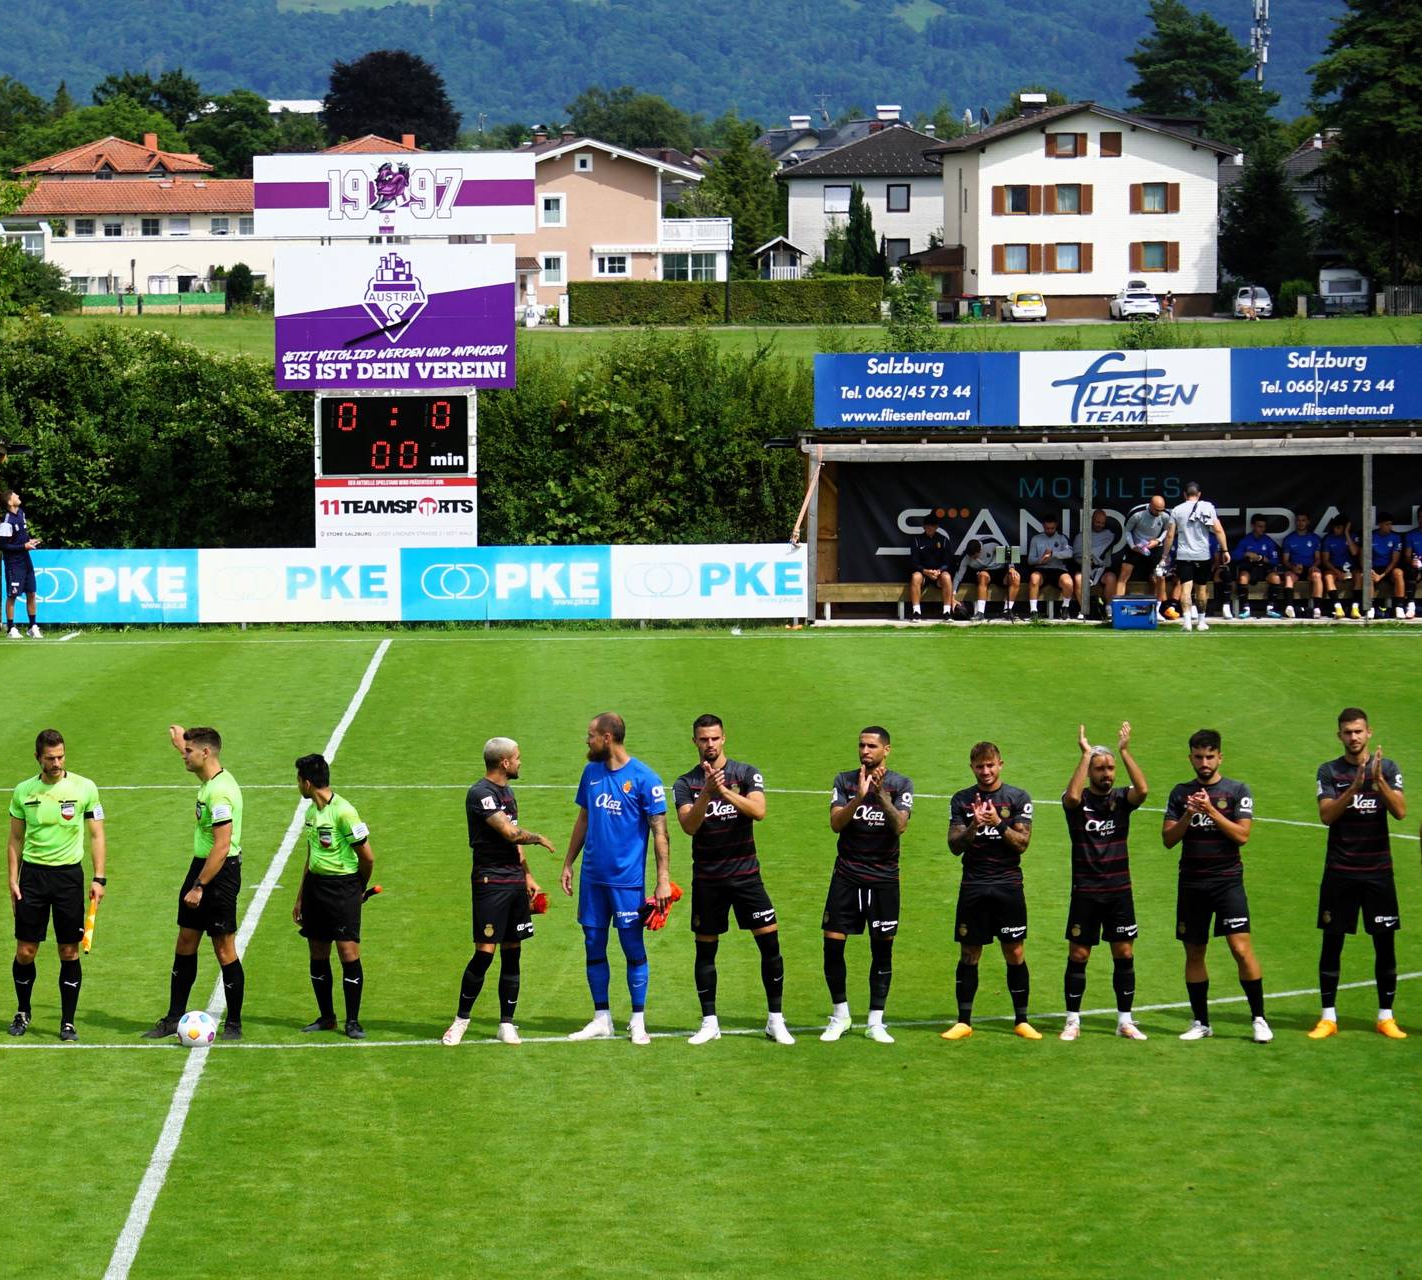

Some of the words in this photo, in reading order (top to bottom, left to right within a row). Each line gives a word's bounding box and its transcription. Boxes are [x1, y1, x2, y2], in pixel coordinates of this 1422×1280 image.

[368, 291, 421, 302] AUSTRIA
[282, 350, 318, 364] JETZT
[316, 348, 377, 362] MITGLIED
[377, 347, 426, 360] WERDEN
[426, 345, 452, 358] UND
[452, 344, 508, 357] ANPACKEN
[1288, 350, 1368, 372] Salzburg
[284, 362, 311, 380] ES
[315, 362, 353, 380] IST
[356, 362, 411, 379] DEIN
[414, 361, 508, 379] VEREIN!
[866, 356, 945, 378] Salzburg
[840, 386, 863, 400] Tel.
[865, 385, 926, 401] 0662/45
[930, 385, 948, 398] 73
[952, 385, 971, 398] 44
[1260, 380, 1283, 394] Tel.
[1286, 379, 1349, 396] 0662/45
[1352, 380, 1372, 392] 73
[1375, 379, 1395, 392] 44
[337, 401, 357, 431] 0
[431, 401, 451, 430] 0
[841, 408, 972, 422] www.fliesenteam.at
[1084, 410, 1147, 423] TEAM
[1260, 402, 1395, 417] www.fliesenteam.at
[370, 440, 419, 469] 00
[429, 452, 465, 466] min
[320, 497, 474, 517] 11TEAMSPORTS
[83, 566, 187, 603] PKE
[285, 564, 389, 600] PKE
[495, 562, 600, 599] PKE
[699, 562, 803, 597] PKE
